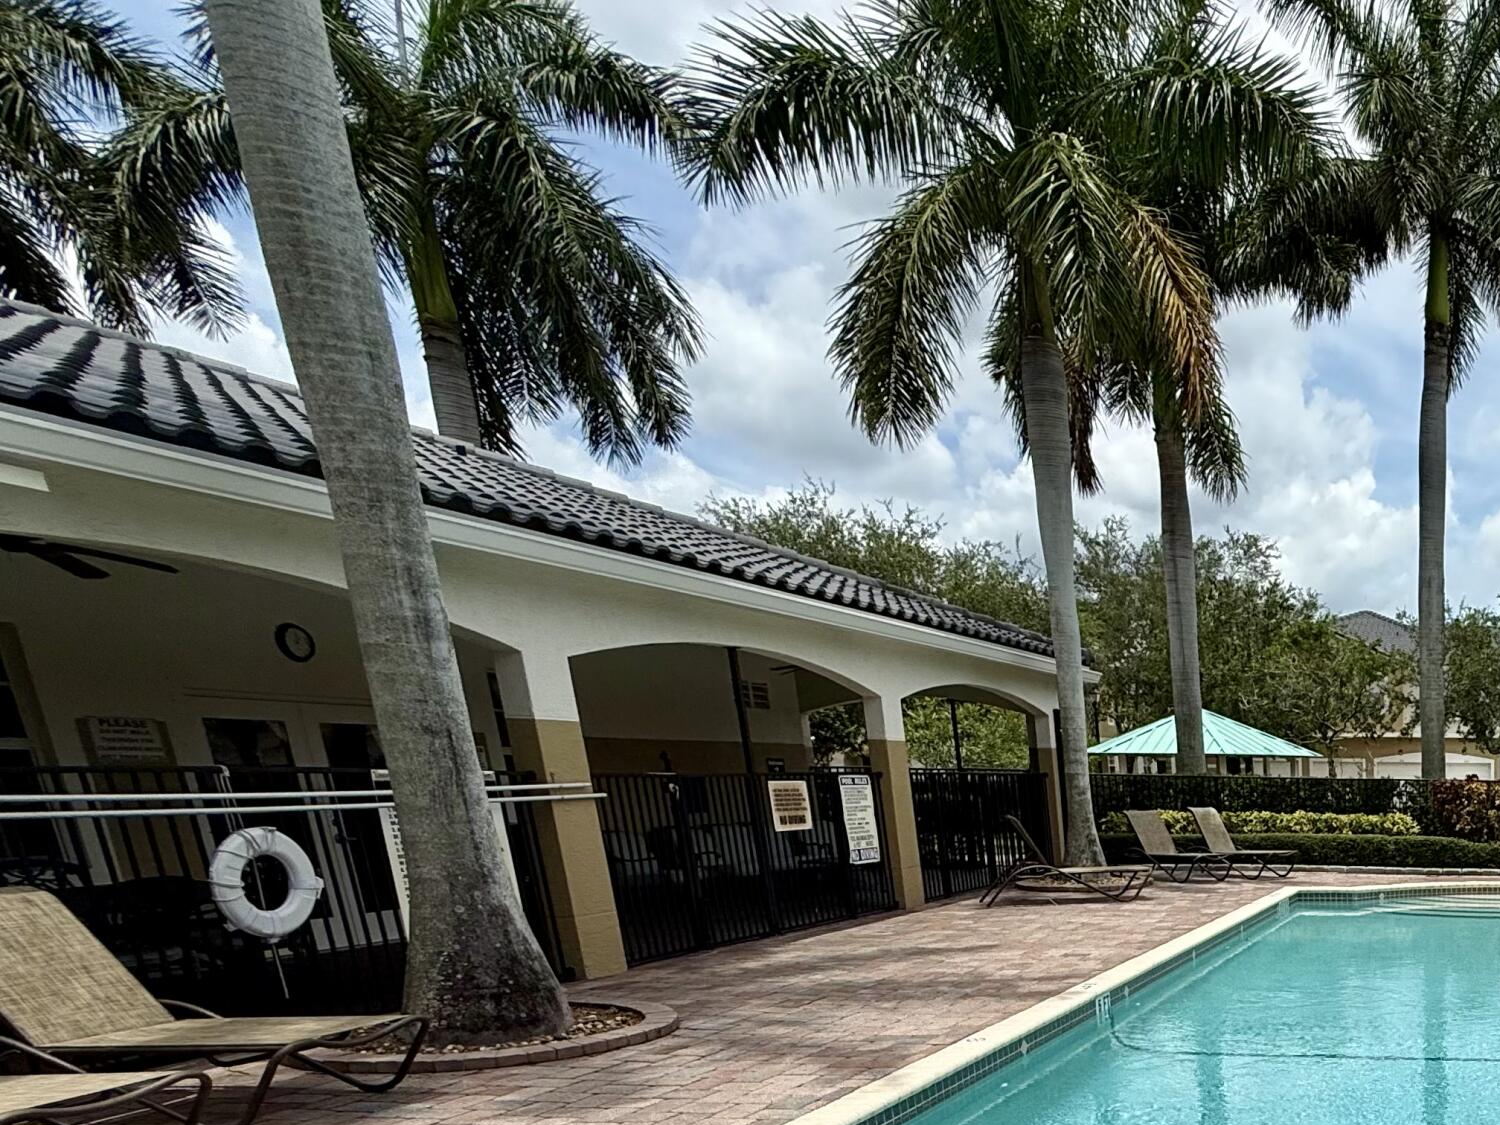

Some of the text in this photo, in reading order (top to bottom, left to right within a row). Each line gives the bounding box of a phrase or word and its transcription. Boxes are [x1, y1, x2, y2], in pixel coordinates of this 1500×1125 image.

[98, 718, 147, 728] PLEASE
[779, 815, 806, 825] NO DIVING
[852, 849, 878, 861] NO DIVING
